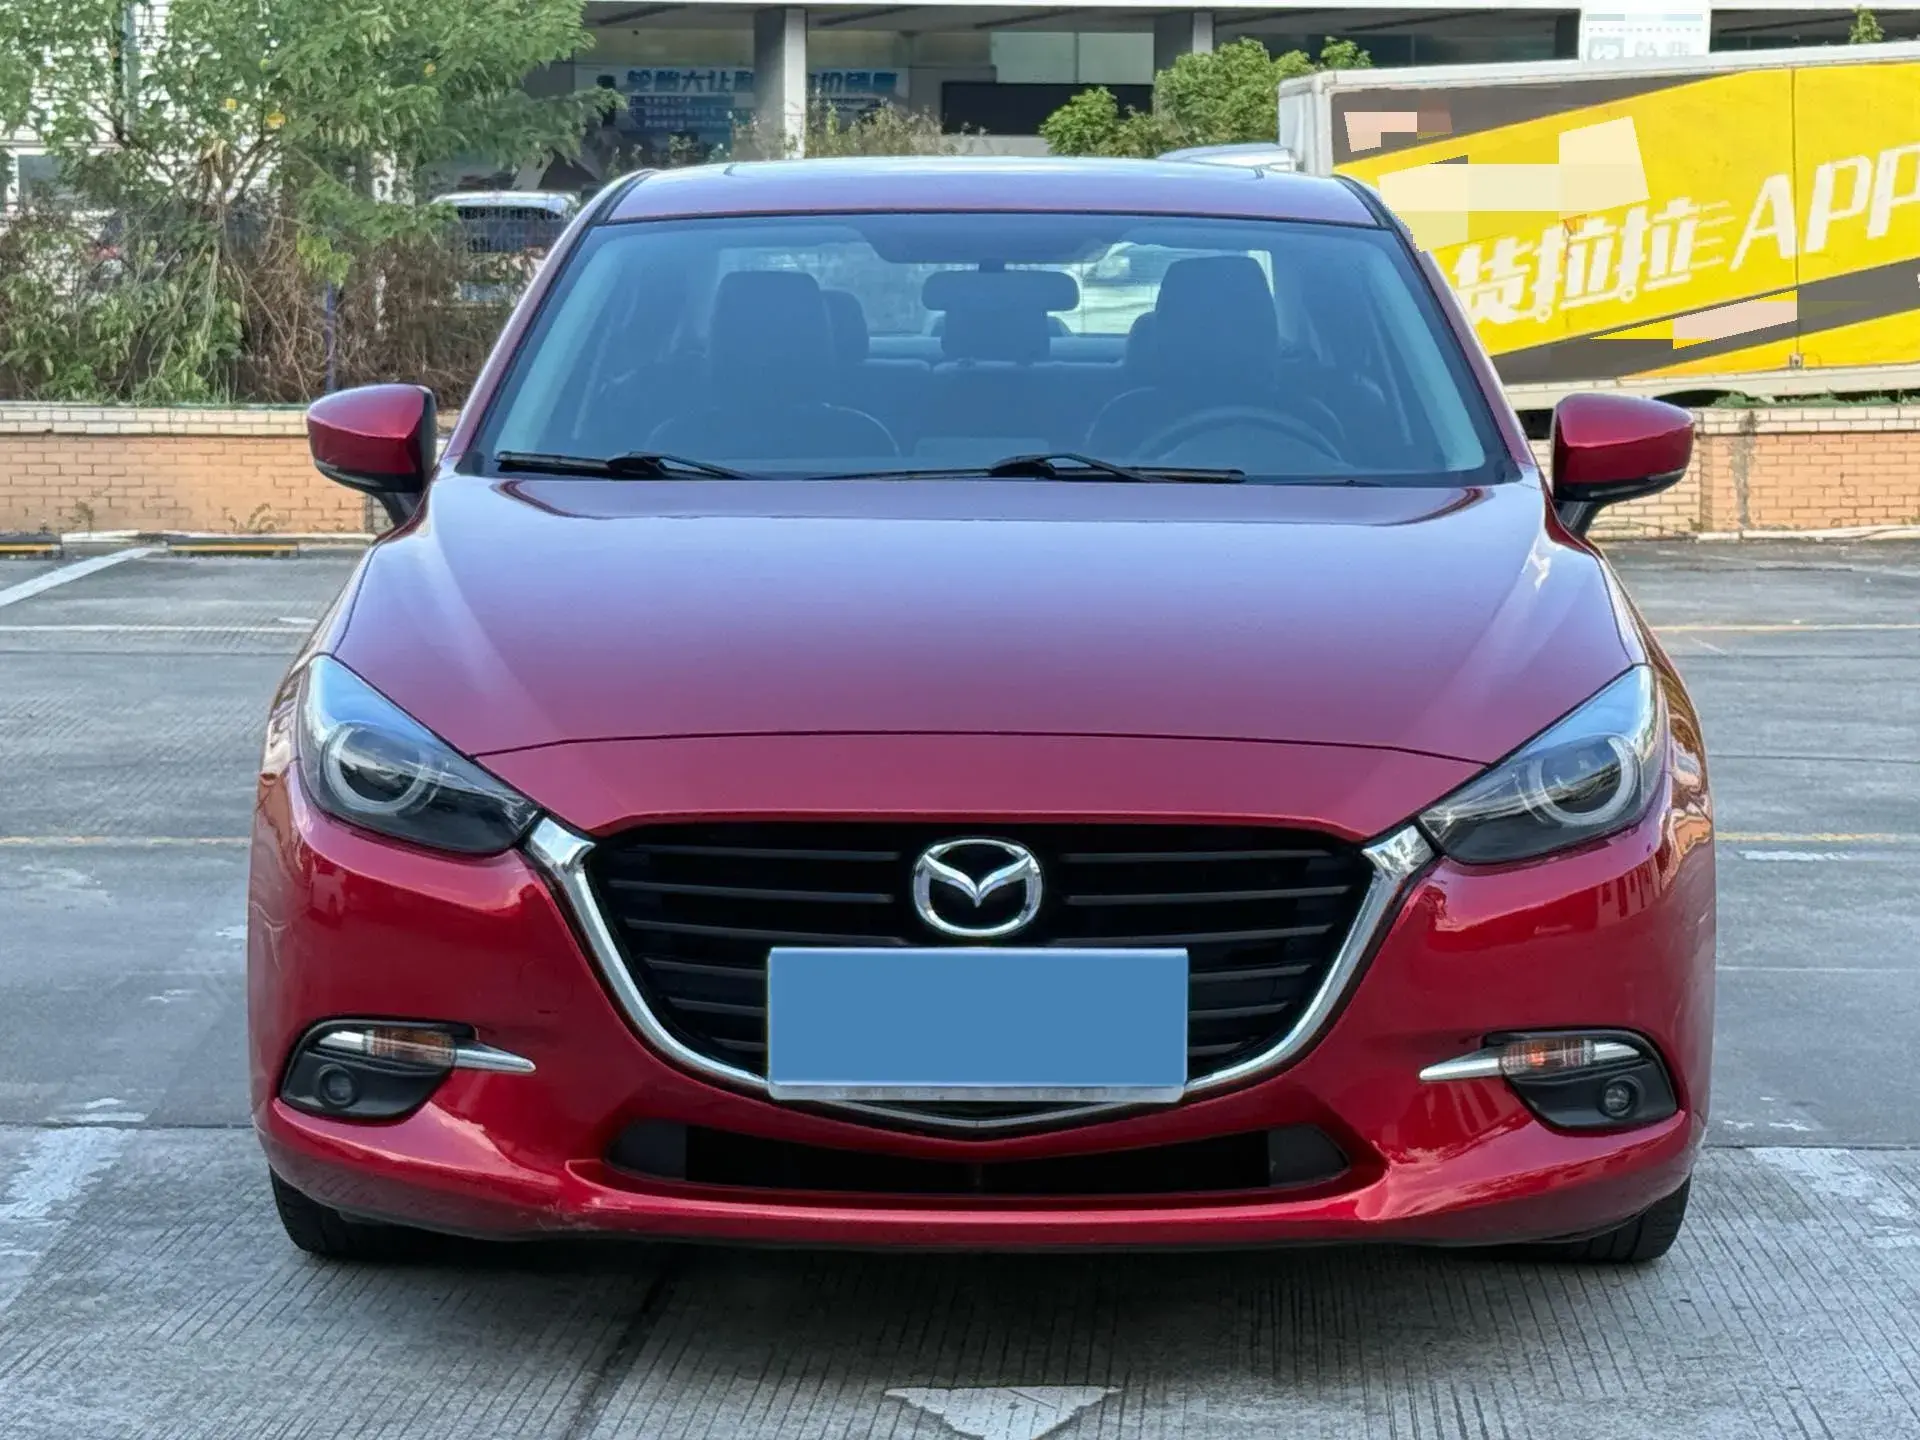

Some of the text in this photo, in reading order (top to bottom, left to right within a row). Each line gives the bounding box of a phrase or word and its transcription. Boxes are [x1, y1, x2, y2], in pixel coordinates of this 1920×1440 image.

[1452, 142, 1920, 324] 货拉拉 APP
